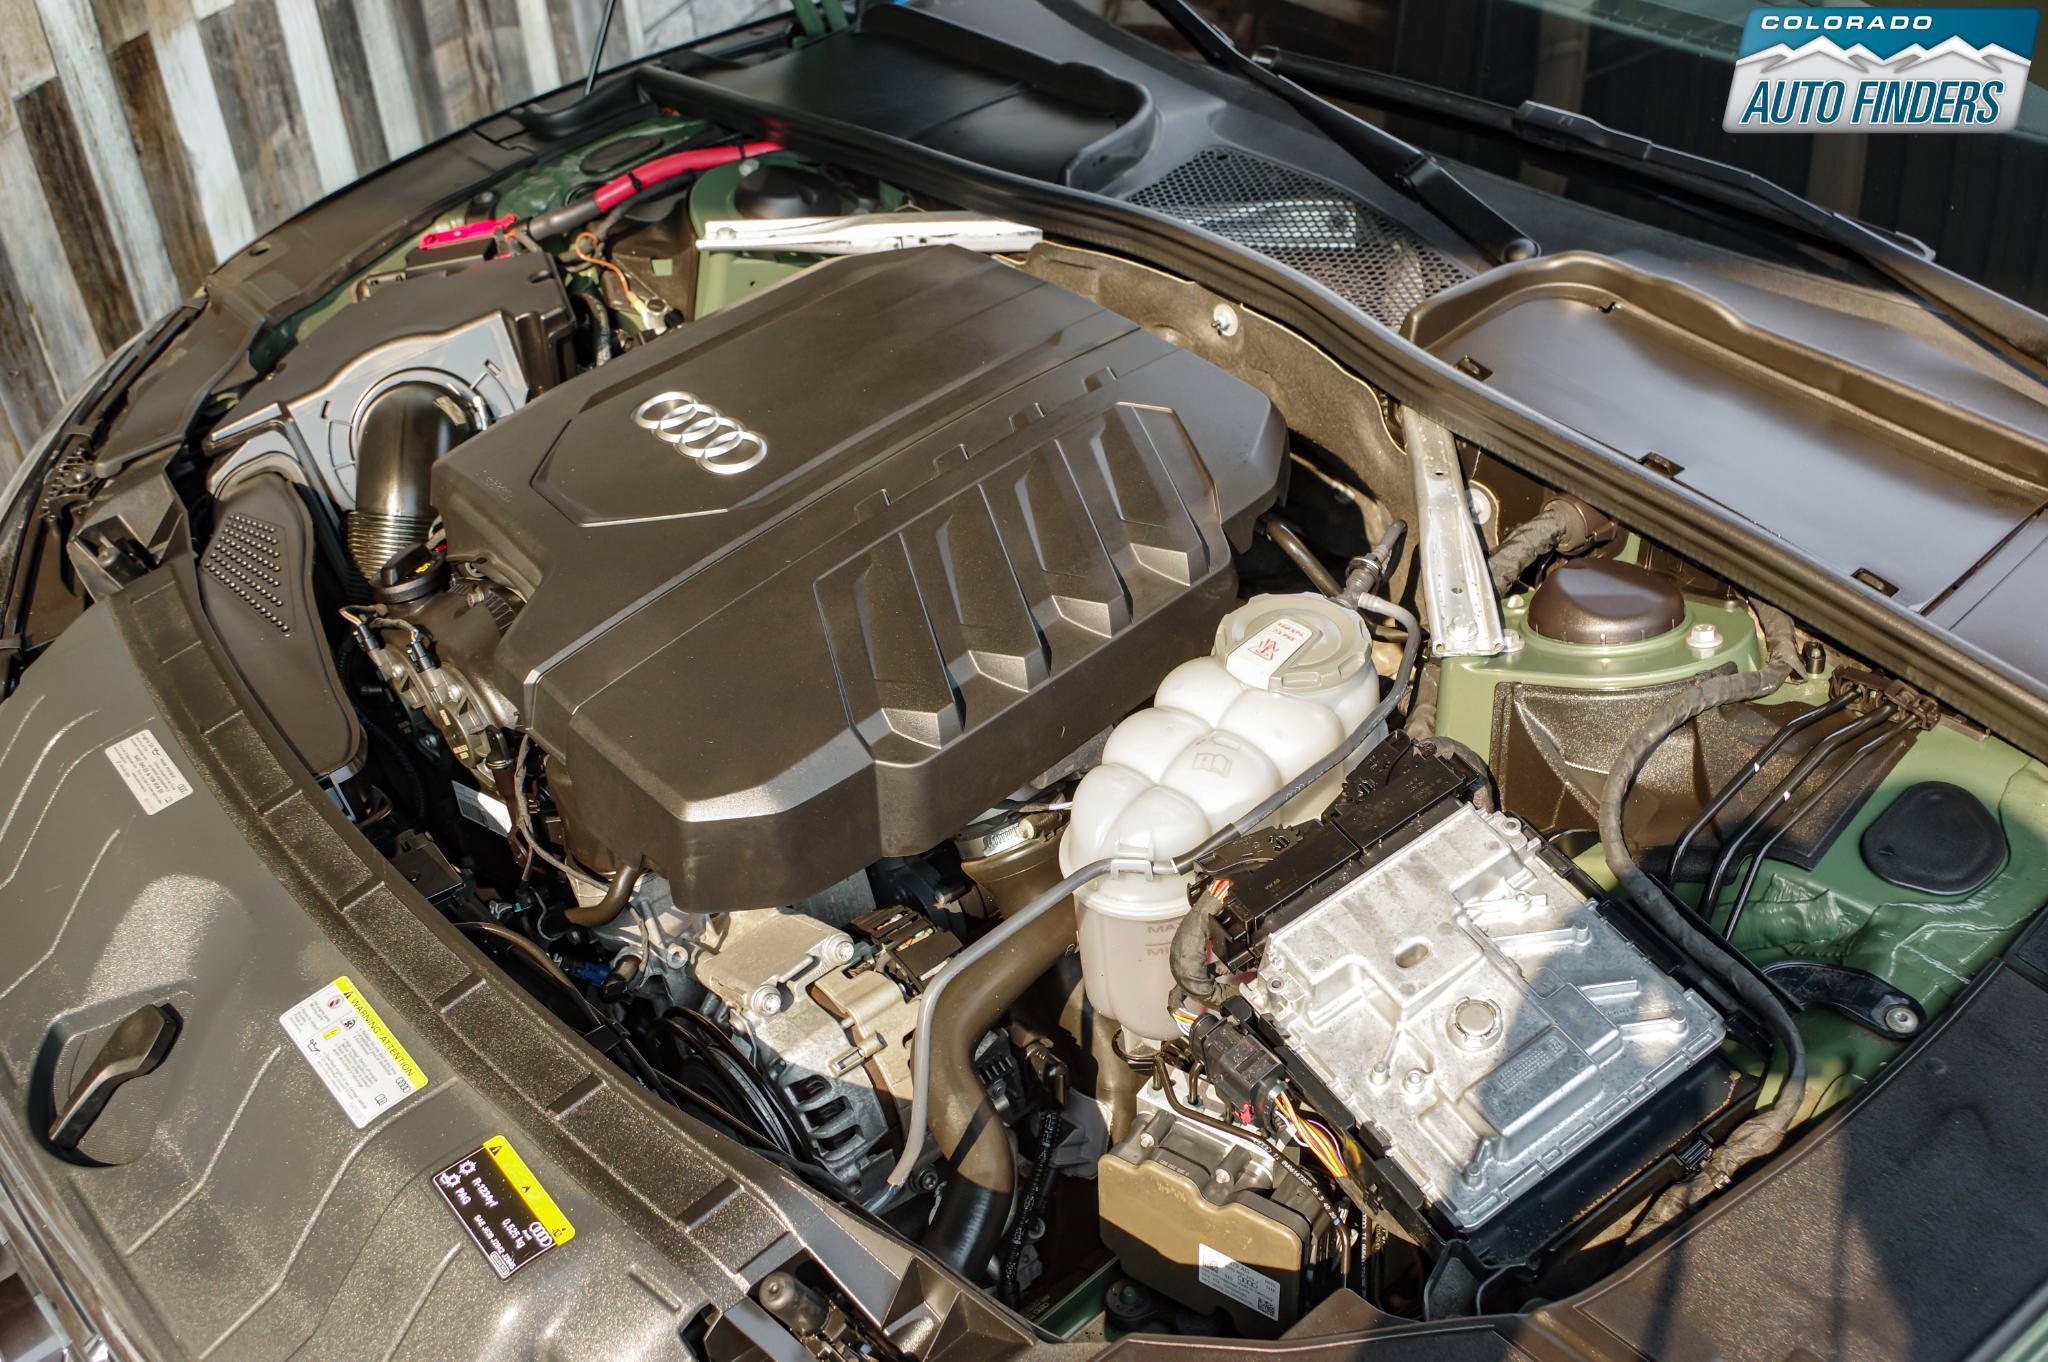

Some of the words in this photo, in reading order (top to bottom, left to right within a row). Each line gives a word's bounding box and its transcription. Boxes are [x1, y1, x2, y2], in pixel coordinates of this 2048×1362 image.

[351, 998, 381, 1034] WARNING
[379, 1036, 415, 1077] ATTENTION
[454, 1187, 472, 1206] PAG
[474, 1214, 486, 1228] SAE
[501, 1218, 521, 1239] 0,525
[515, 1235, 526, 1249] kg
